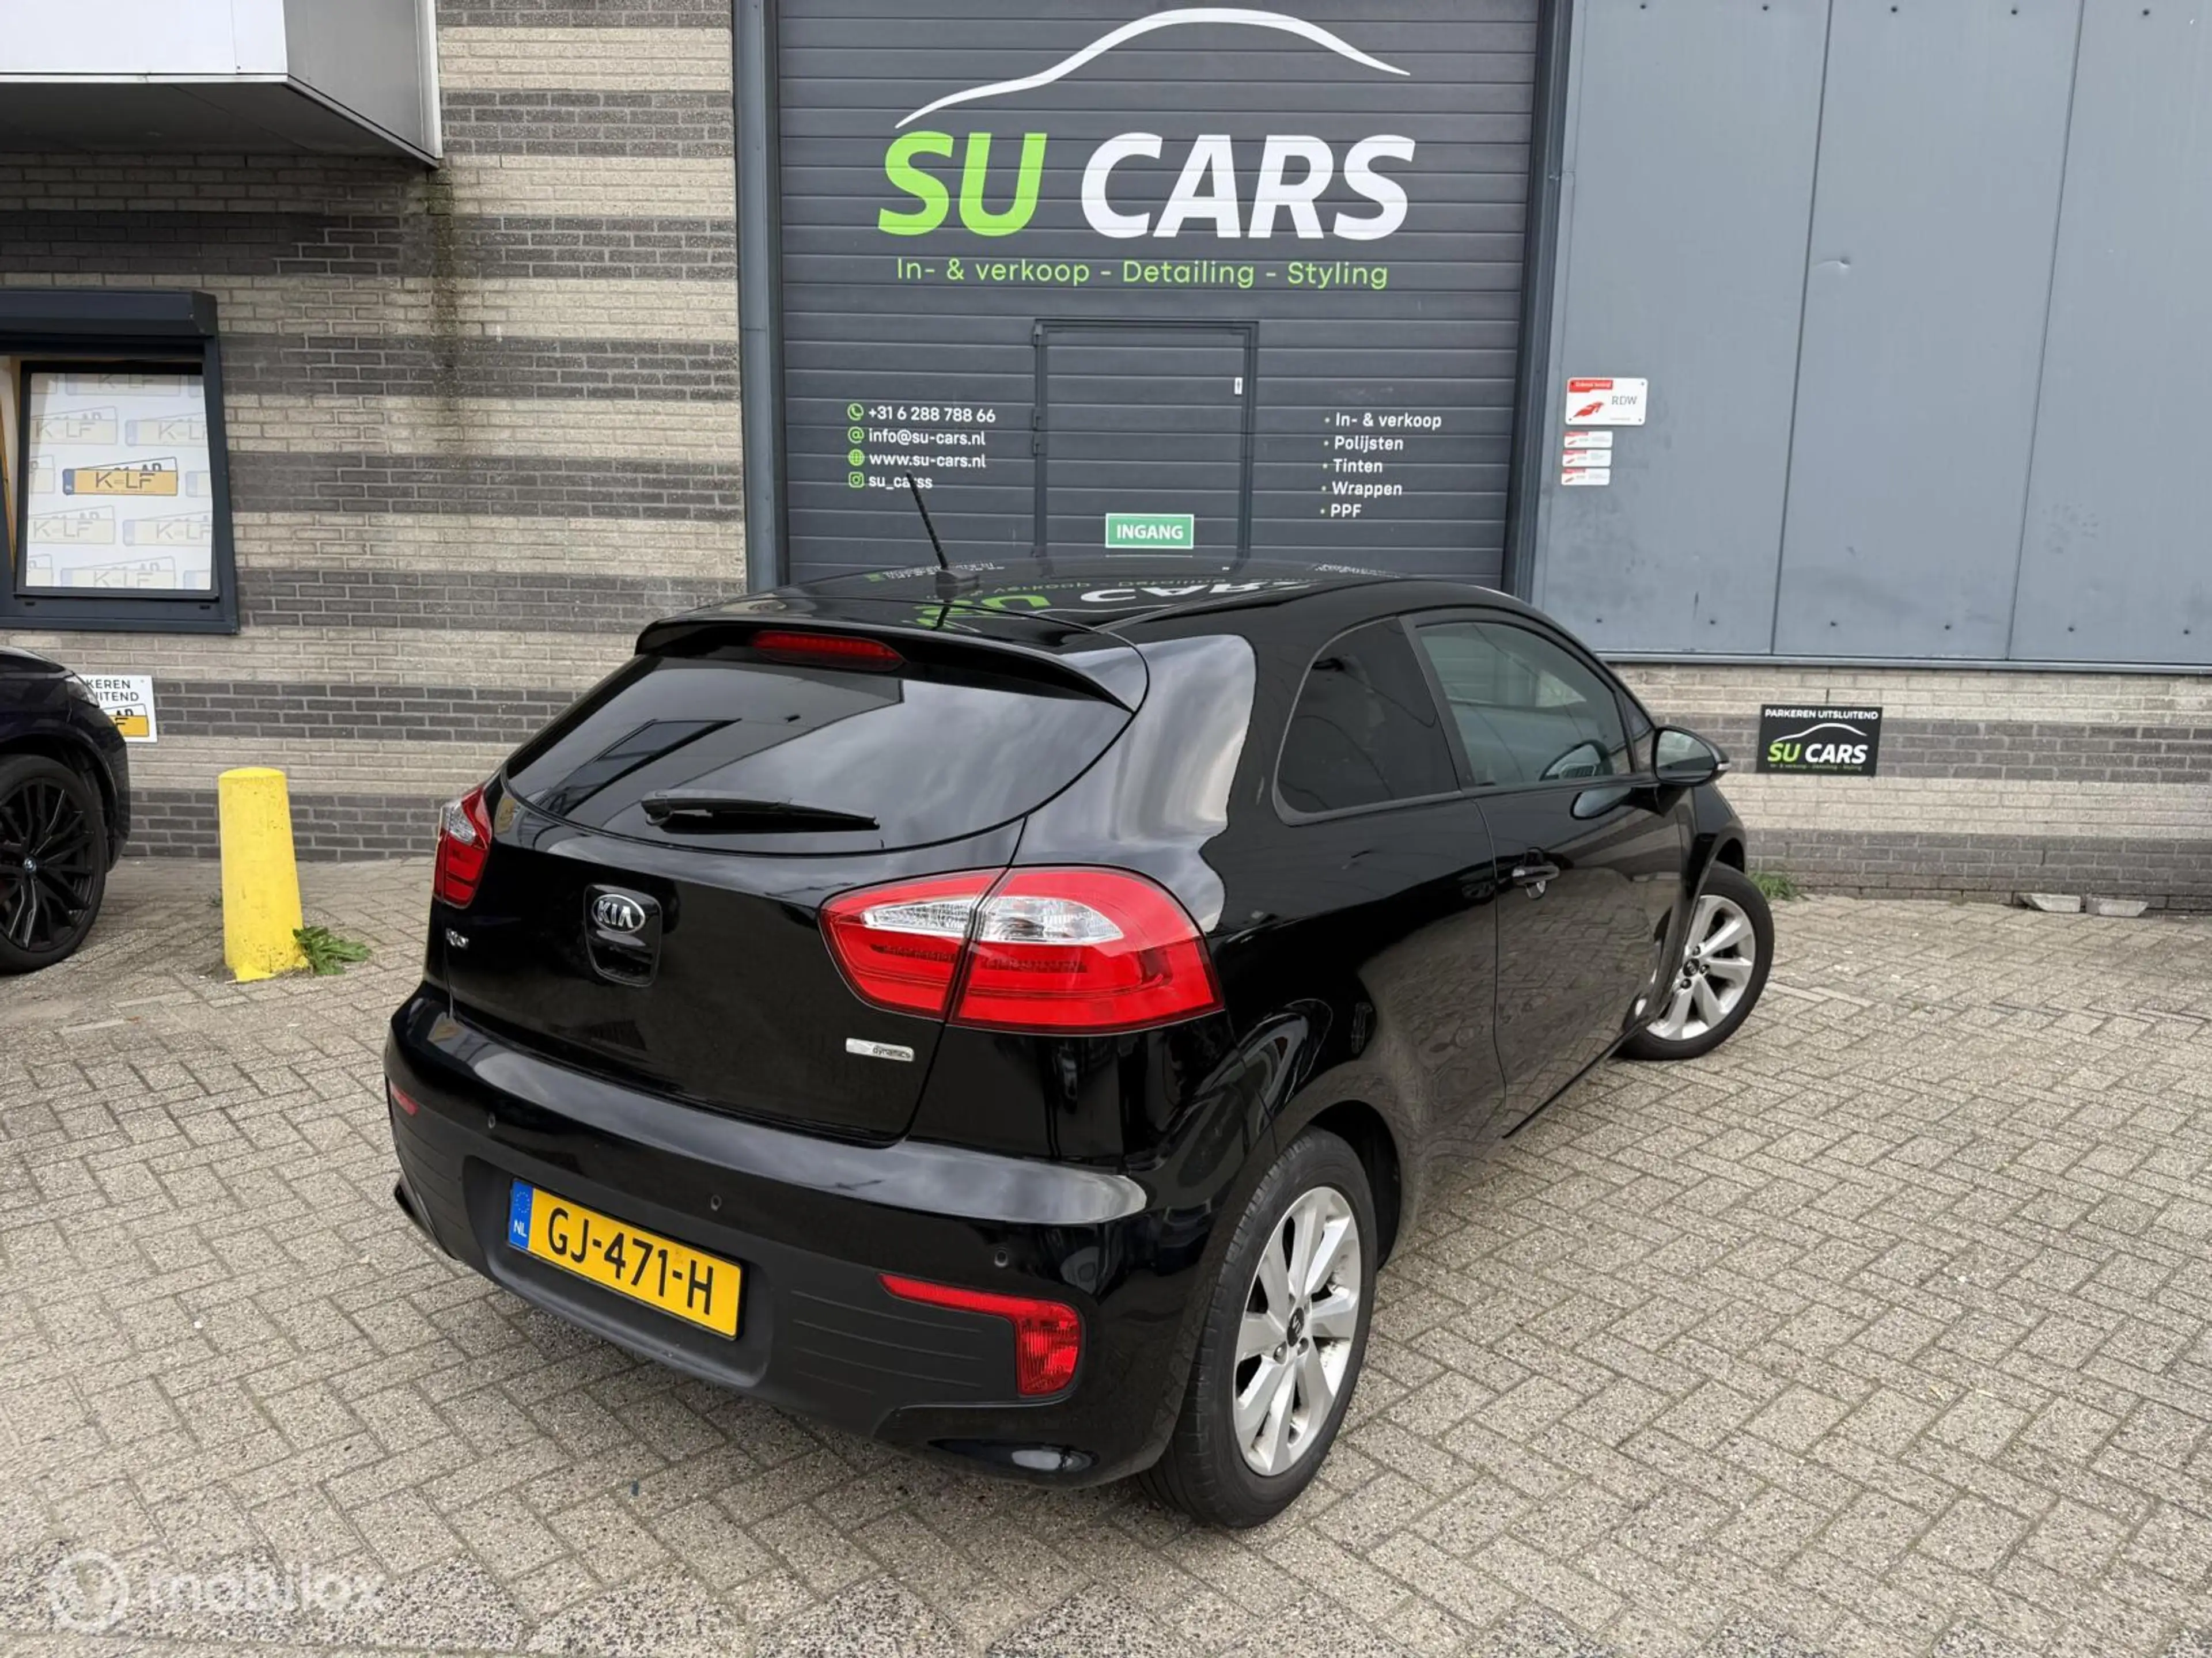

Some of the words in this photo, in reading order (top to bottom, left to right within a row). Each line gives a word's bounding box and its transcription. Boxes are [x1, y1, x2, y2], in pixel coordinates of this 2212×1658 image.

[878, 131, 1047, 237] SU
[1081, 132, 1416, 241] CARS
[897, 258, 935, 279] In-
[946, 258, 965, 280] &
[975, 259, 1090, 287] verkoop
[1123, 260, 1254, 288] Detailing
[1287, 261, 1388, 290] Styling
[1611, 395, 1637, 405] RDW
[869, 406, 893, 420] +31
[897, 407, 907, 420] 6
[911, 407, 940, 422] 288
[944, 408, 972, 422] 788
[976, 409, 995, 423] 66
[1335, 412, 1357, 427] In-
[1363, 412, 1374, 427] &
[1379, 412, 1442, 430] verkoop
[869, 428, 986, 445] info@su-cars.nl
[1335, 435, 1403, 453] Polijsten
[869, 454, 986, 468] www.su-cars.nl
[1333, 458, 1382, 473] Tinten
[869, 476, 933, 490] su_cass
[1332, 481, 1402, 498] Wrappen
[1331, 503, 1362, 517] PPF
[1116, 525, 1184, 540] INGANG
[1764, 708, 1816, 718] PARKEREN
[1817, 710, 1878, 720] UITSLUITEND
[1767, 742, 1801, 762] SU
[1805, 743, 1869, 764] CARS
[597, 900, 634, 928] KIA
[513, 1220, 527, 1238] NL
[547, 1206, 714, 1315] GJ-471-H
